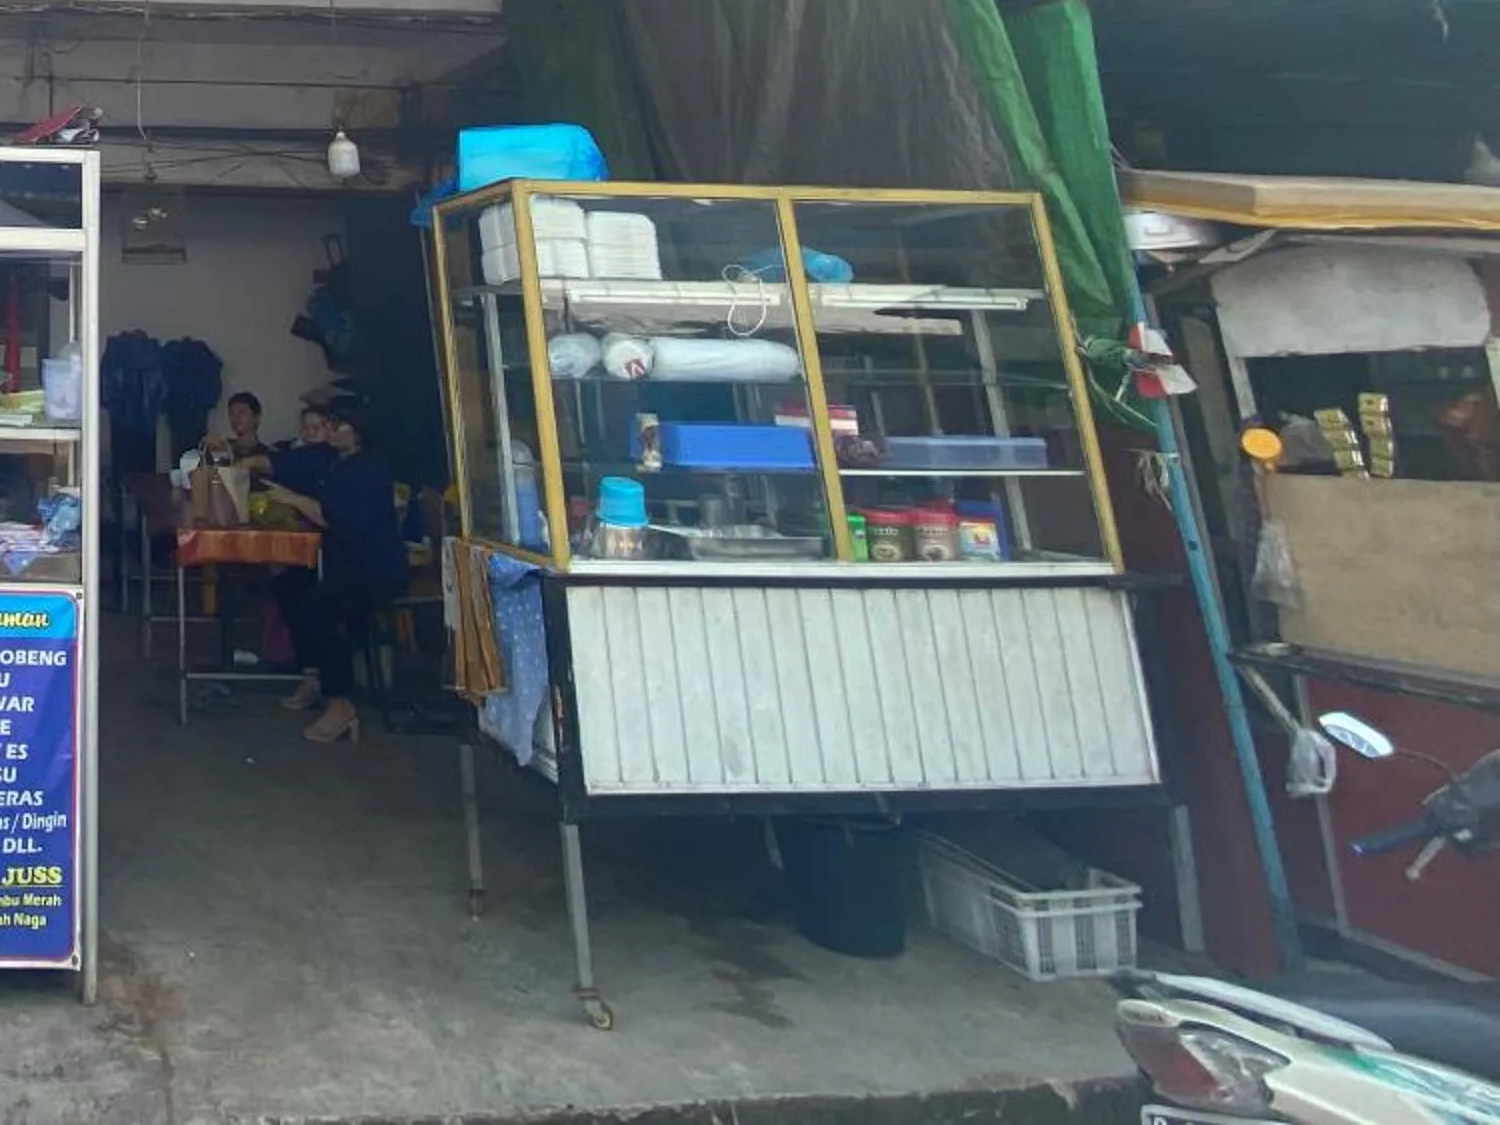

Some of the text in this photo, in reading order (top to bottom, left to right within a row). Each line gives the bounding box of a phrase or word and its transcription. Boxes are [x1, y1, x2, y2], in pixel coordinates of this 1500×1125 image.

[0, 650, 67, 666] OBENG
[6, 744, 28, 760] ES
[22, 811, 68, 833] Dingin
[3, 837, 43, 853] DLL.
[1, 866, 63, 887] JUSS
[23, 893, 62, 907] Merah
[14, 912, 47, 929] Naga
